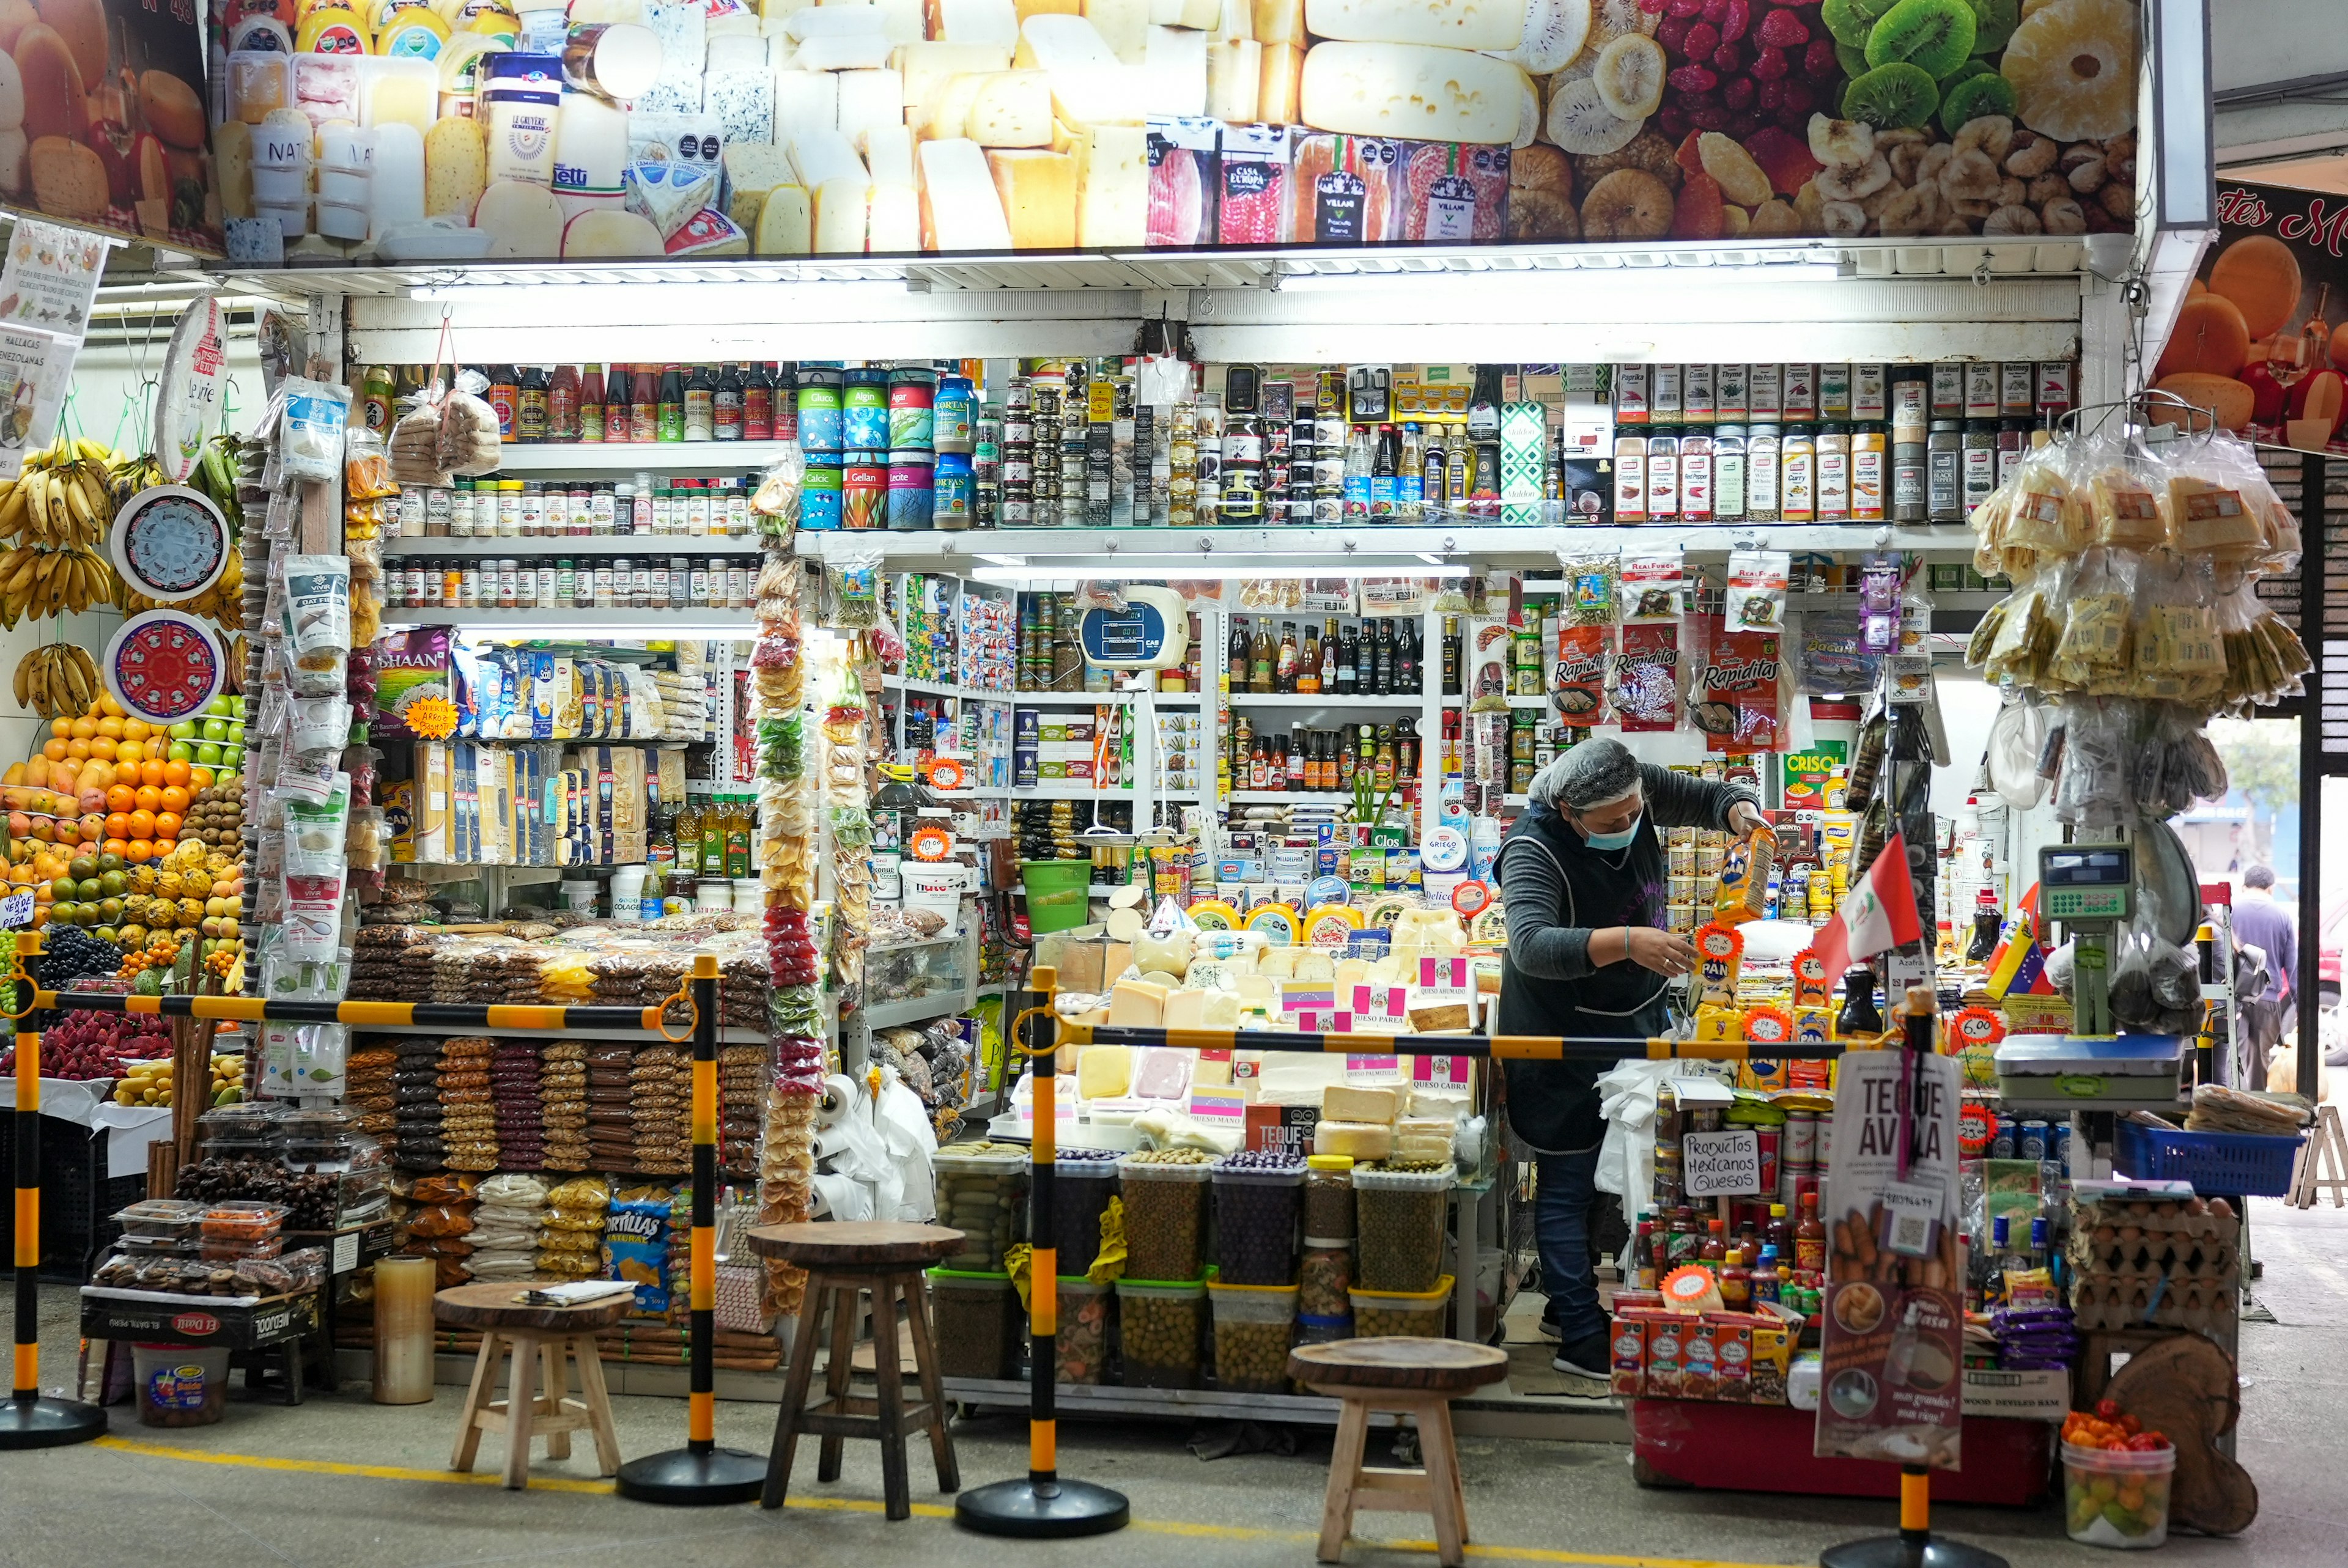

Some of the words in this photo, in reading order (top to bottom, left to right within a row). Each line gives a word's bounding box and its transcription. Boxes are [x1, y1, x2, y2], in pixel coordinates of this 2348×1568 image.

[673, 164, 706, 177] CAMBOZOLA
[1236, 167, 1258, 175] CASA
[1230, 173, 1264, 185] EUROPA
[1326, 199, 1354, 208] VILLANI
[1439, 203, 1465, 212] VILLANI
[5, 336, 40, 349] HALLACAS
[0, 351, 45, 366] ENEZOLANAS
[2004, 364, 2029, 373] Nutmeg
[811, 393, 834, 402] Gluco
[855, 392, 874, 403] Algin
[892, 393, 907, 403] Agar
[807, 474, 829, 483] Calcic
[852, 473, 876, 482] Gellan
[890, 473, 909, 482] Lecite
[1615, 646, 1680, 675] Rapiditas
[1703, 659, 1780, 690] Rapiditas
[1375, 834, 1400, 847] Clos
[1722, 864, 1744, 878] PAN
[5, 895, 33, 912] VERDE
[9, 893, 23, 903] UVA
[2, 915, 24, 928] PEPA
[1710, 928, 1732, 937] OFERTA
[1702, 963, 1729, 977] PAN
[1757, 1012, 1781, 1020] OFERTA
[2040, 1014, 2054, 1025] LA
[1964, 1020, 1991, 1035] 6.00
[1414, 1081, 1439, 1090] QUESO
[1441, 1082, 1467, 1091] CABRA
[1260, 1125, 1301, 1145] TEQUE
[1694, 1173, 1753, 1191] Quesos
[255, 1311, 290, 1333] MEDJOOL
